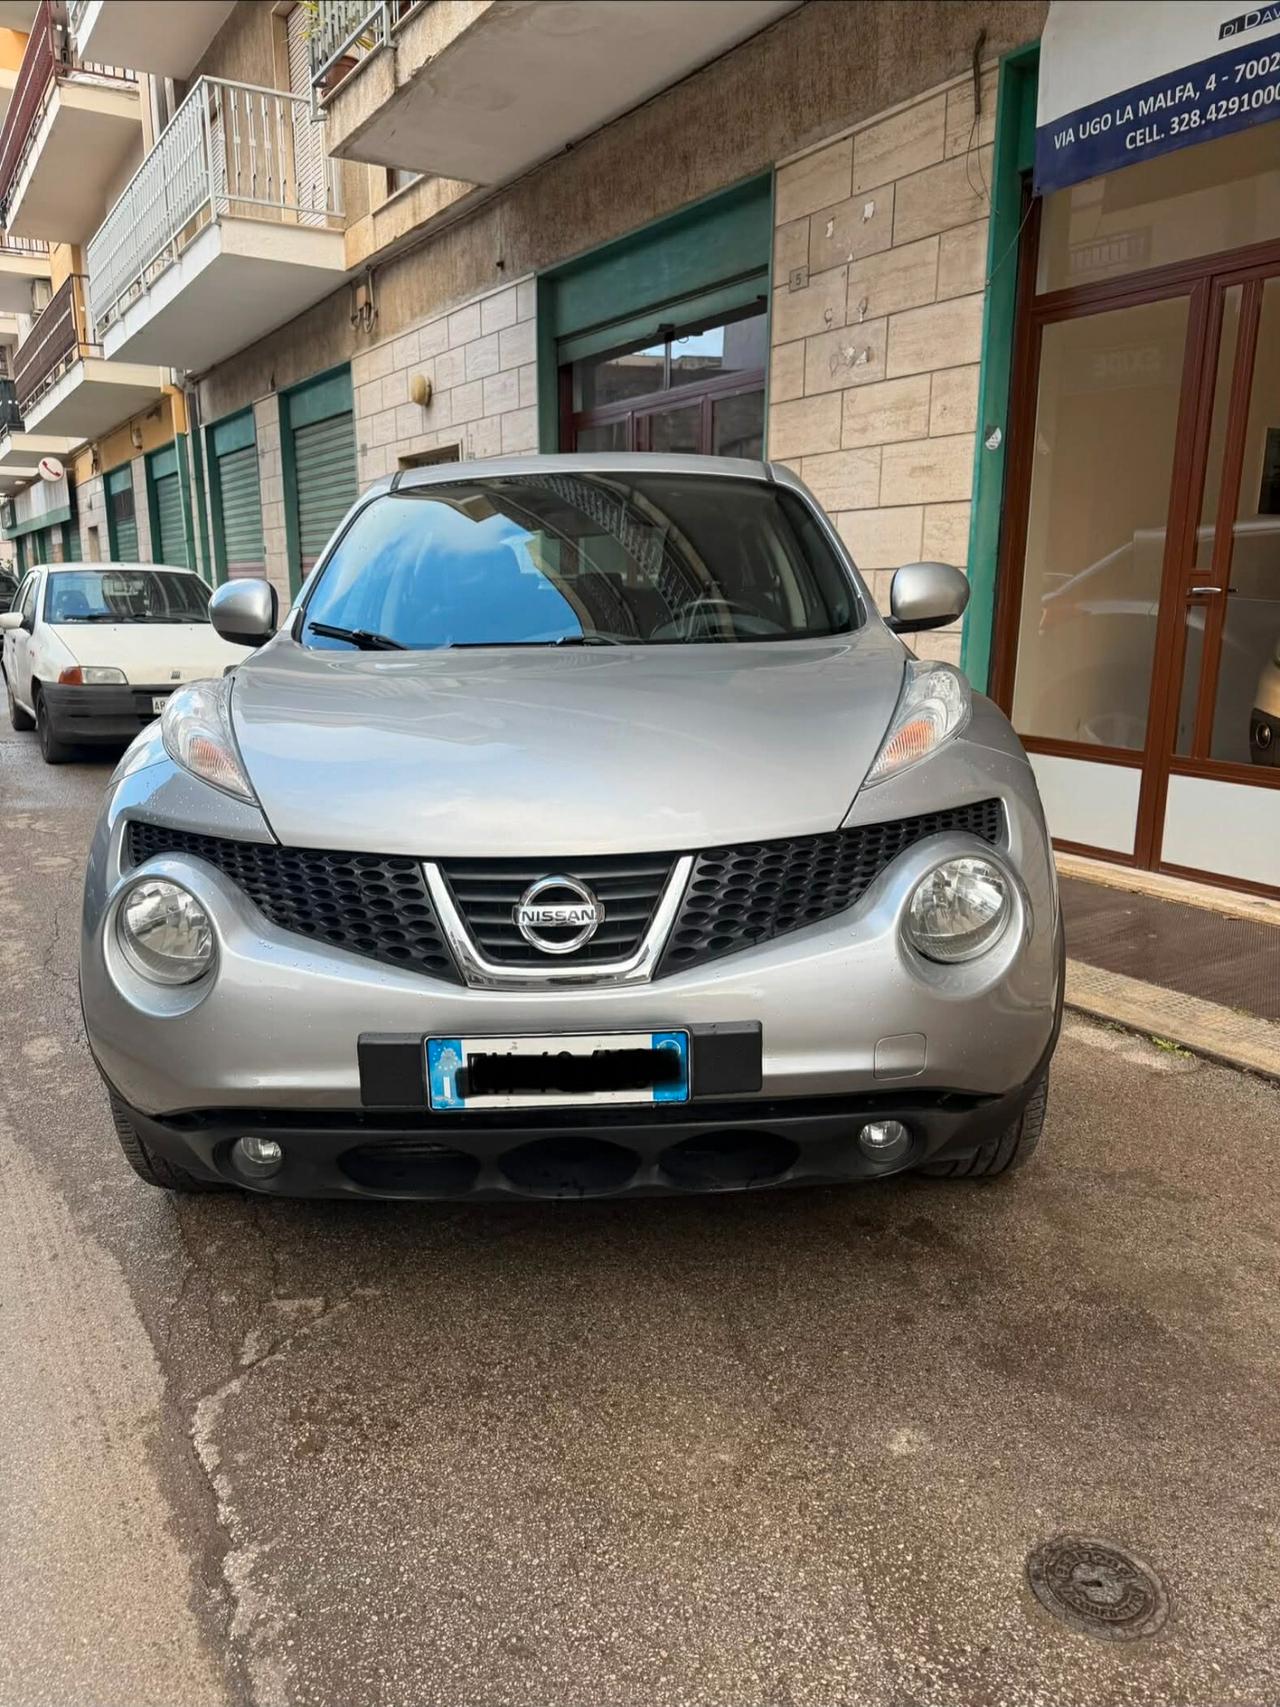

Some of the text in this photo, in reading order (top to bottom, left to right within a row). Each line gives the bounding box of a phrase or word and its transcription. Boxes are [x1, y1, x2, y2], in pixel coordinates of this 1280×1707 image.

[1223, 22, 1238, 38] DI
[1054, 128, 1075, 150] VIA
[1079, 113, 1112, 139] UGO
[1116, 104, 1134, 126] LA
[1138, 81, 1200, 117] MALFA,
[1205, 73, 1217, 92] 4
[1125, 123, 1165, 150] CELL.
[795, 272, 802, 286] 5
[522, 909, 595, 922] NISSAN
